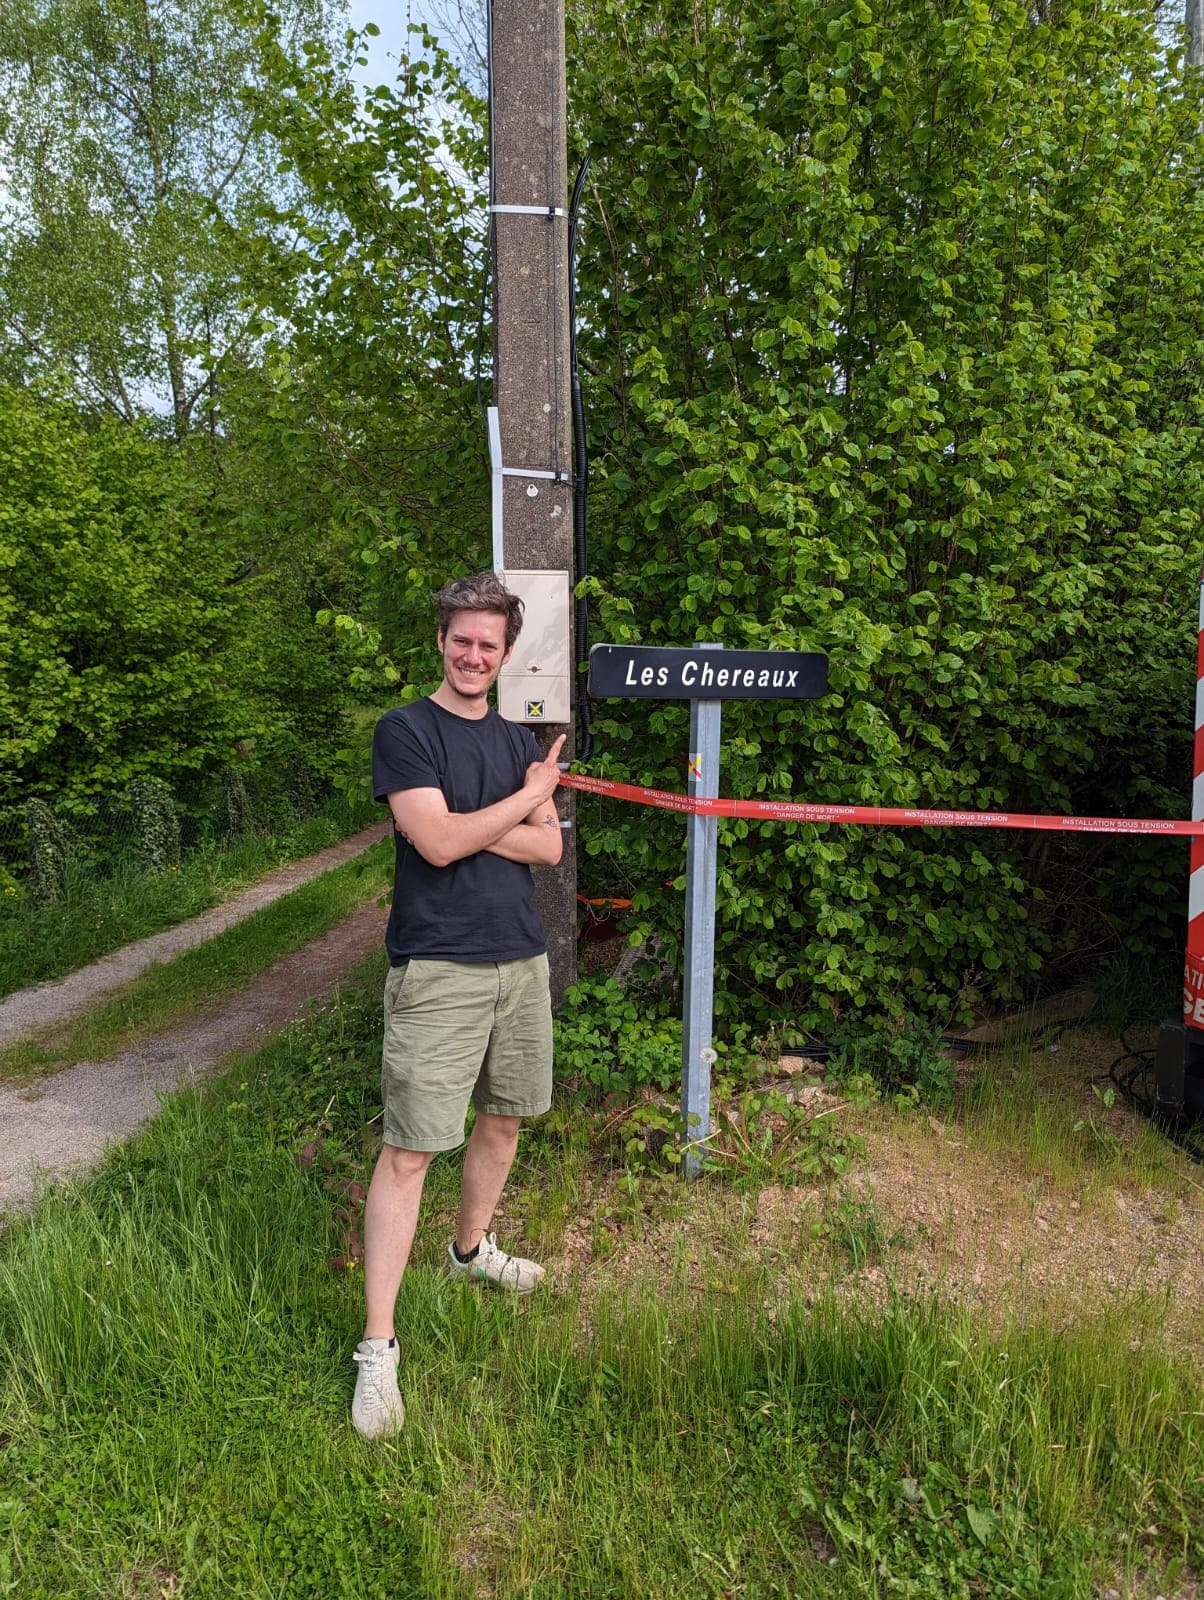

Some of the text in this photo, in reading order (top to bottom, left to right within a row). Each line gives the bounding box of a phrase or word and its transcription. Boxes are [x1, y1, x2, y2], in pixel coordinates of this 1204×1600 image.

[625, 660, 799, 688] Les Chereaux
[644, 790, 674, 800] INSTALLATION
[675, 795, 687, 803] SOUS
[759, 804, 804, 812] INSTALLATION
[904, 811, 954, 819] INSTALLATION
[1062, 818, 1115, 827] INSTALLATION
[1184, 965, 1204, 990] ATI
